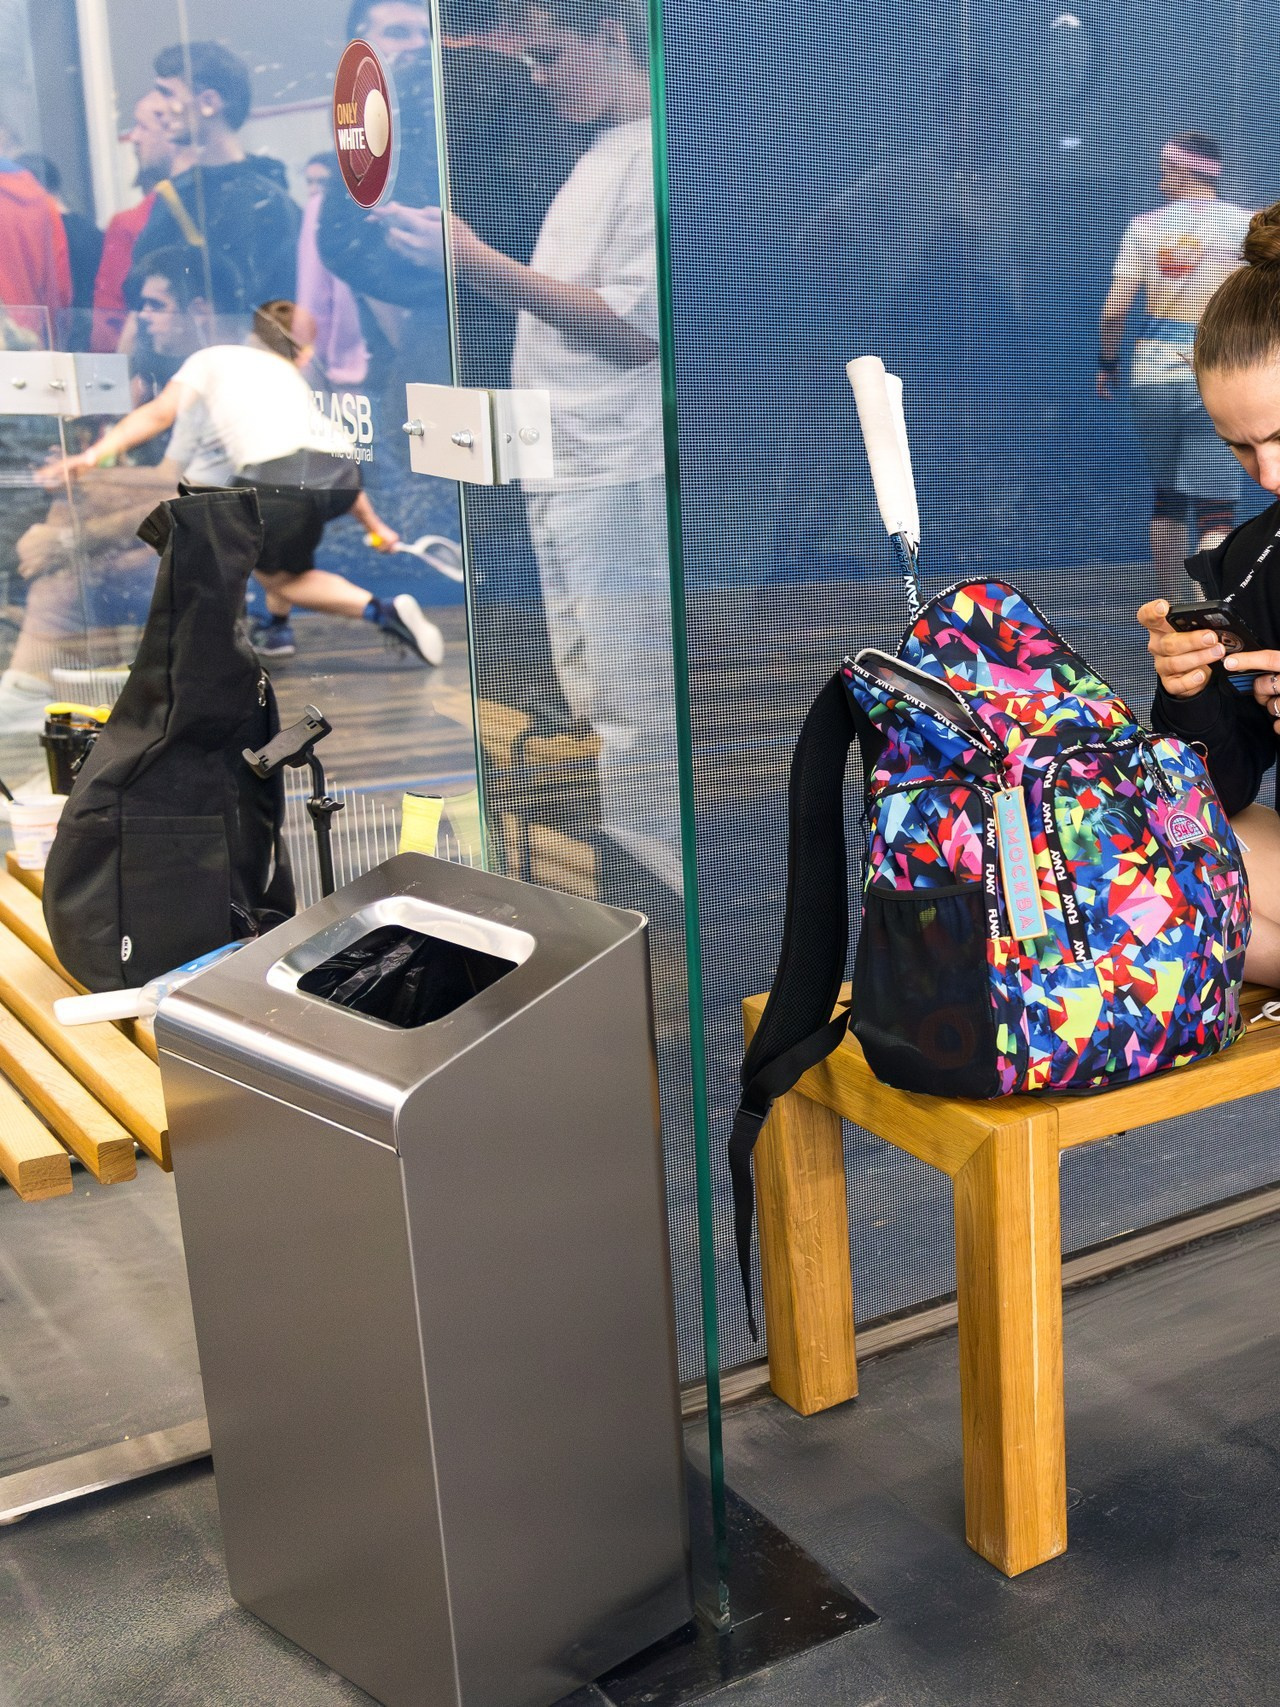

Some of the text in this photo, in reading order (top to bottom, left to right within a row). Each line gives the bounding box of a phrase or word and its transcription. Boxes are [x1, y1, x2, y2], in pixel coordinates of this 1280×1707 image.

[337, 102, 358, 126] ONLY
[338, 127, 365, 151] WHITE
[330, 392, 374, 444] ASB
[1043, 761, 1059, 789] FUNKY
[986, 817, 997, 849] FUNKY
[1042, 801, 1055, 835] FUNKY
[985, 863, 996, 896] FUNKY
[1050, 849, 1068, 882] FUNKY
[1062, 893, 1079, 925] FUNKY
